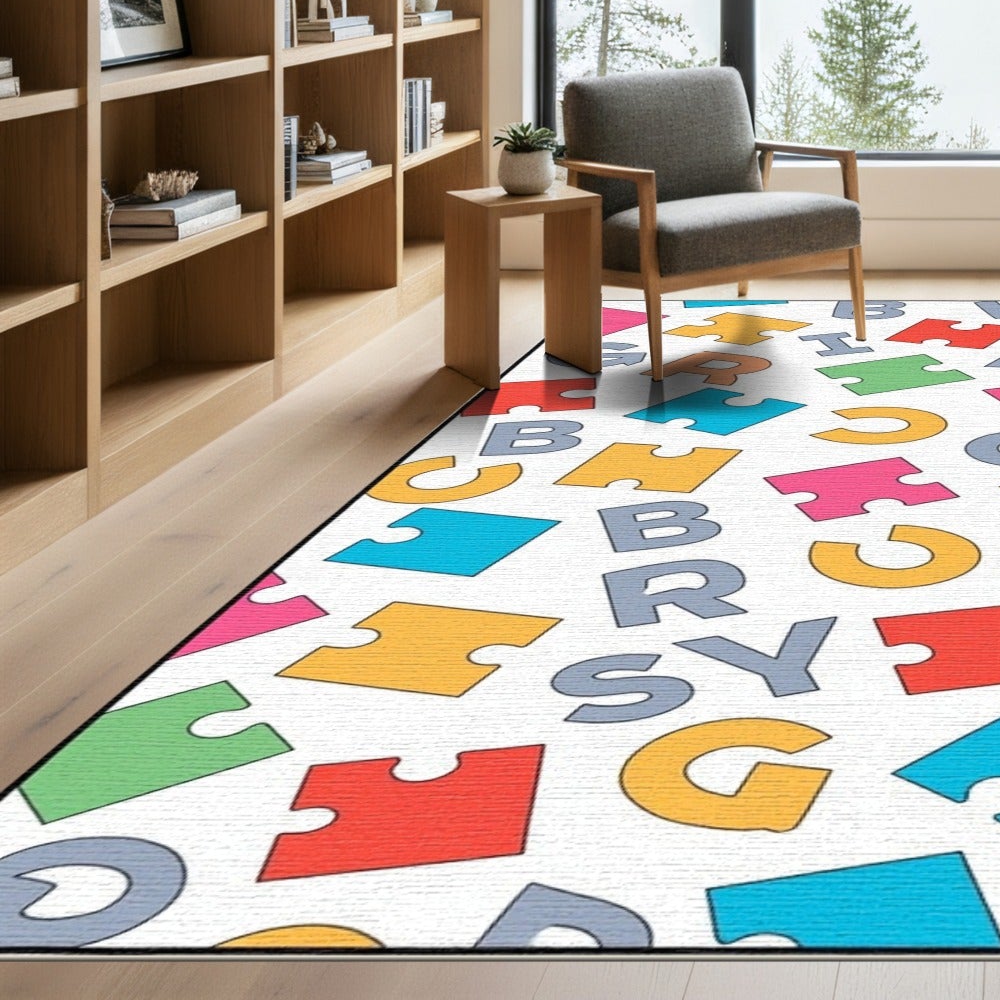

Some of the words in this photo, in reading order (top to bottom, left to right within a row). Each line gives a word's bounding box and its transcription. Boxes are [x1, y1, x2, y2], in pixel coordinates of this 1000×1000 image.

[799, 332, 875, 357] I
[479, 420, 585, 457] B
[597, 500, 722, 553] B
[602, 559, 748, 629] R
[550, 653, 695, 725] S
[672, 616, 838, 698] Y
[618, 716, 834, 834] G
